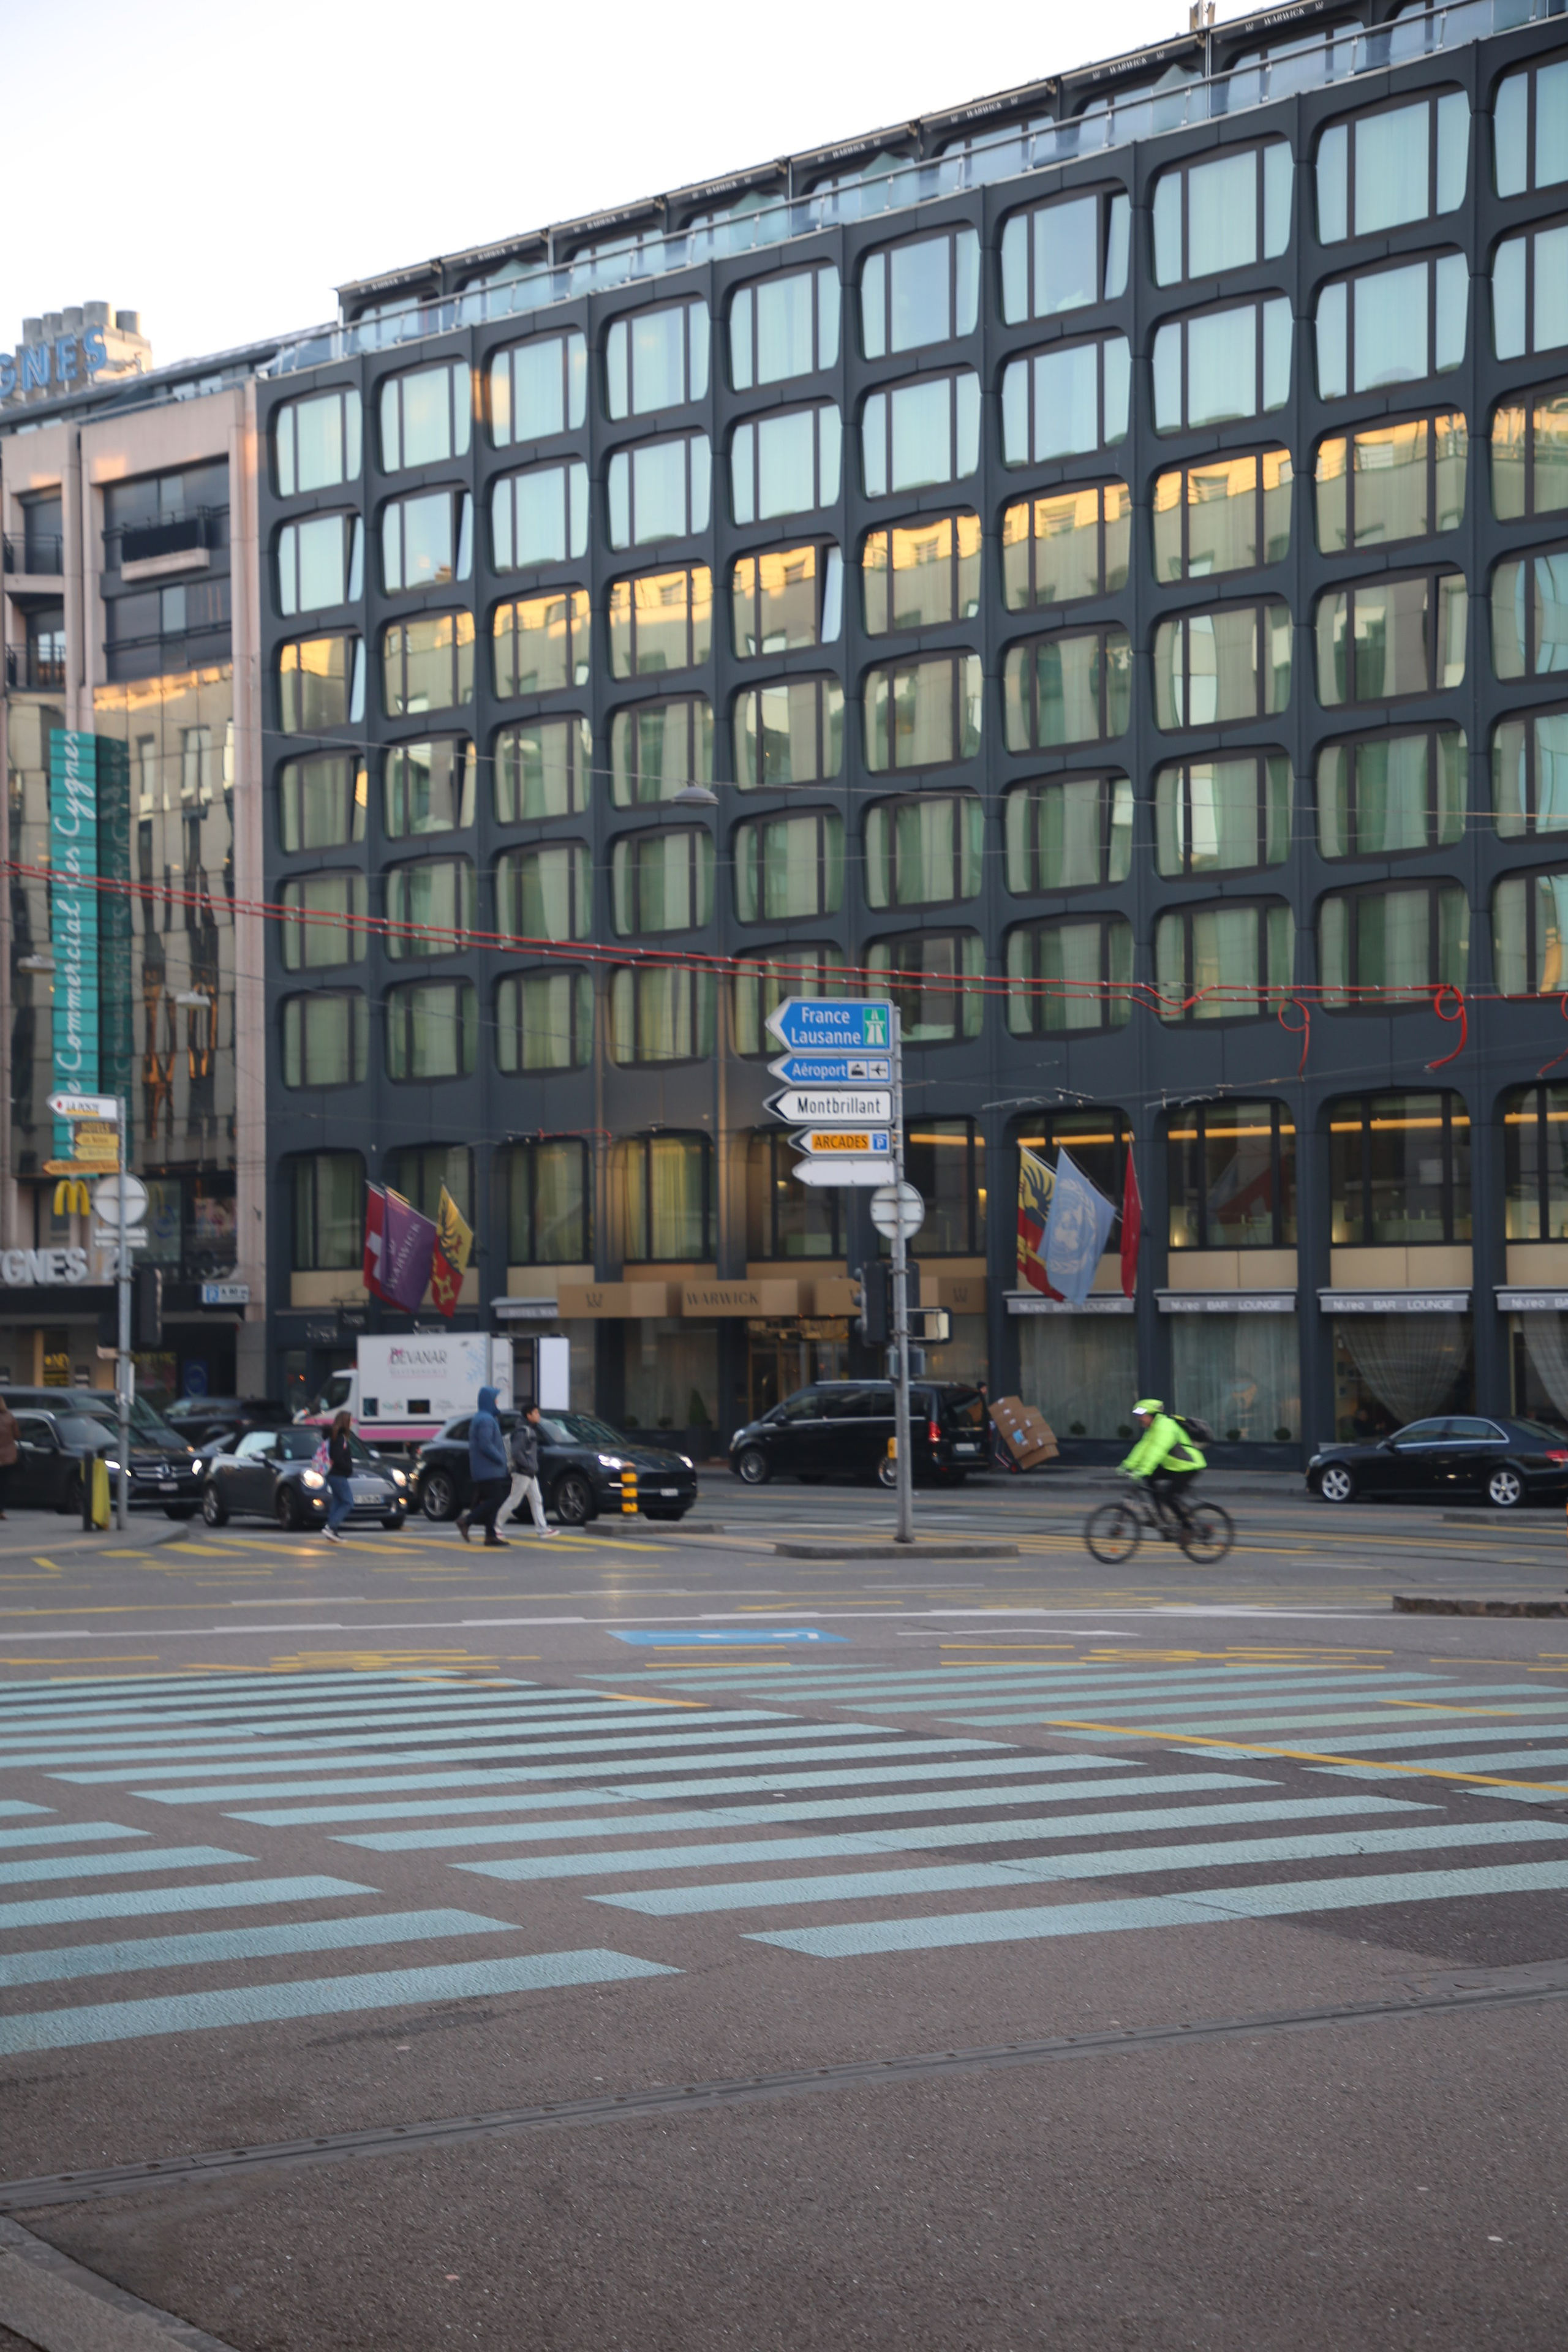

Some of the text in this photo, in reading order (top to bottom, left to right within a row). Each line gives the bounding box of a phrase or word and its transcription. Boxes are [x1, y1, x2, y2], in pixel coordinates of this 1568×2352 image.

[1264, 7, 1305, 26] WARWICK
[1109, 57, 1147, 75] WARWICK
[967, 102, 1002, 119] WARWICK
[55, 731, 96, 837] Cygnes
[56, 899, 81, 1070] Commercial
[802, 1006, 850, 1023] France
[791, 1027, 861, 1045] Lausanne
[792, 1063, 846, 1079] Aéroport
[797, 1096, 881, 1115] Montbrillant
[814, 1134, 869, 1149] ARCADES
[386, 1223, 421, 1289] WARWICK
[687, 1292, 760, 1305] WARWICK
[1207, 1300, 1228, 1310] BAR
[1238, 1300, 1281, 1310] LOUNGE
[1373, 1300, 1396, 1310] BAR
[1407, 1299, 1454, 1310] LOUNGE
